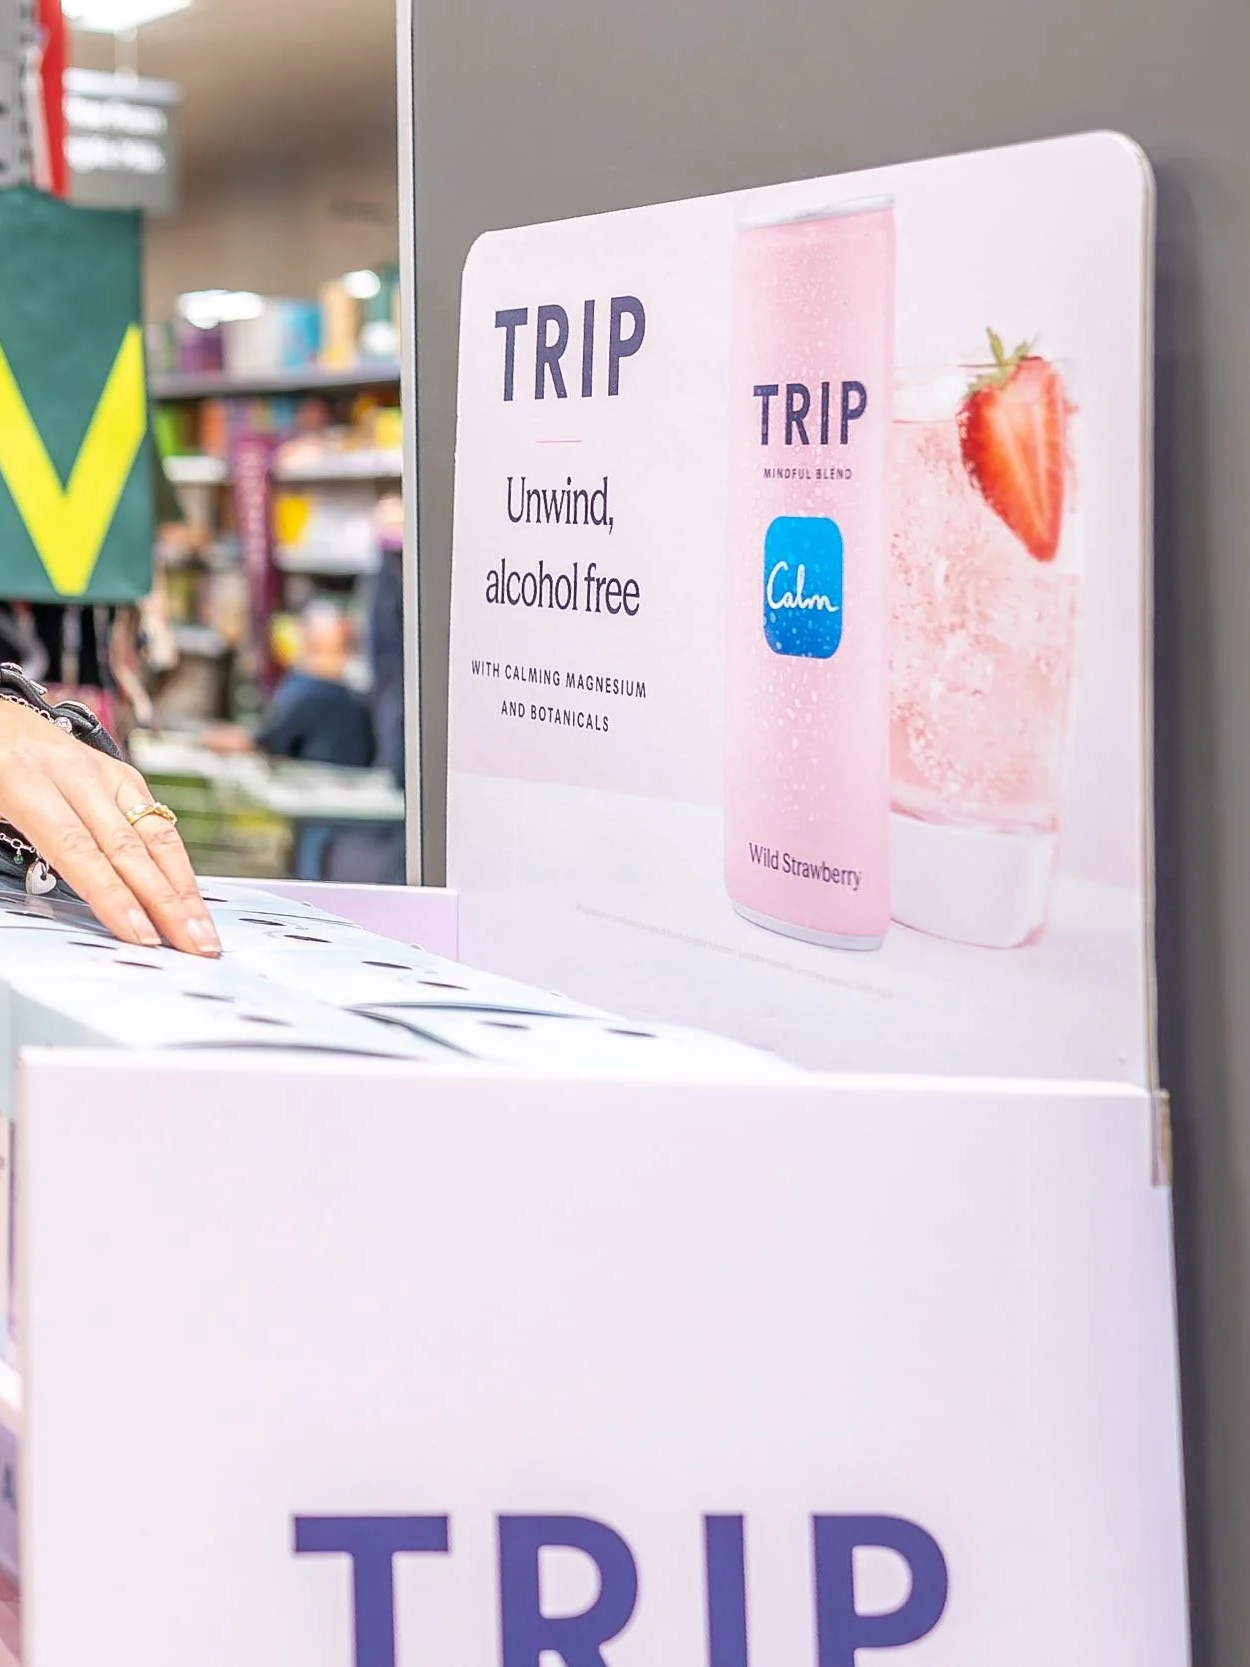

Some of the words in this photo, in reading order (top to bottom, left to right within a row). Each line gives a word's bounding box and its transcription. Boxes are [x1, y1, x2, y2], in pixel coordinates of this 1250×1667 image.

[495, 295, 646, 401] TRIP
[753, 380, 868, 445] TRIP
[764, 468, 811, 480] MINDFUL
[816, 468, 853, 480] BLEND
[507, 476, 614, 535] Unwind,
[485, 558, 579, 611] alcohol
[584, 562, 641, 616] free
[766, 560, 840, 613] Calm
[471, 660, 500, 679] WITH
[505, 664, 560, 686] CALMING
[565, 672, 647, 699] MAGNESIUM
[501, 700, 526, 718] AND
[530, 704, 610, 732] BOTANICALS
[749, 842, 780, 871] Wild
[782, 852, 862, 891] Strawberry
[293, 1513, 949, 1667] TRIP
